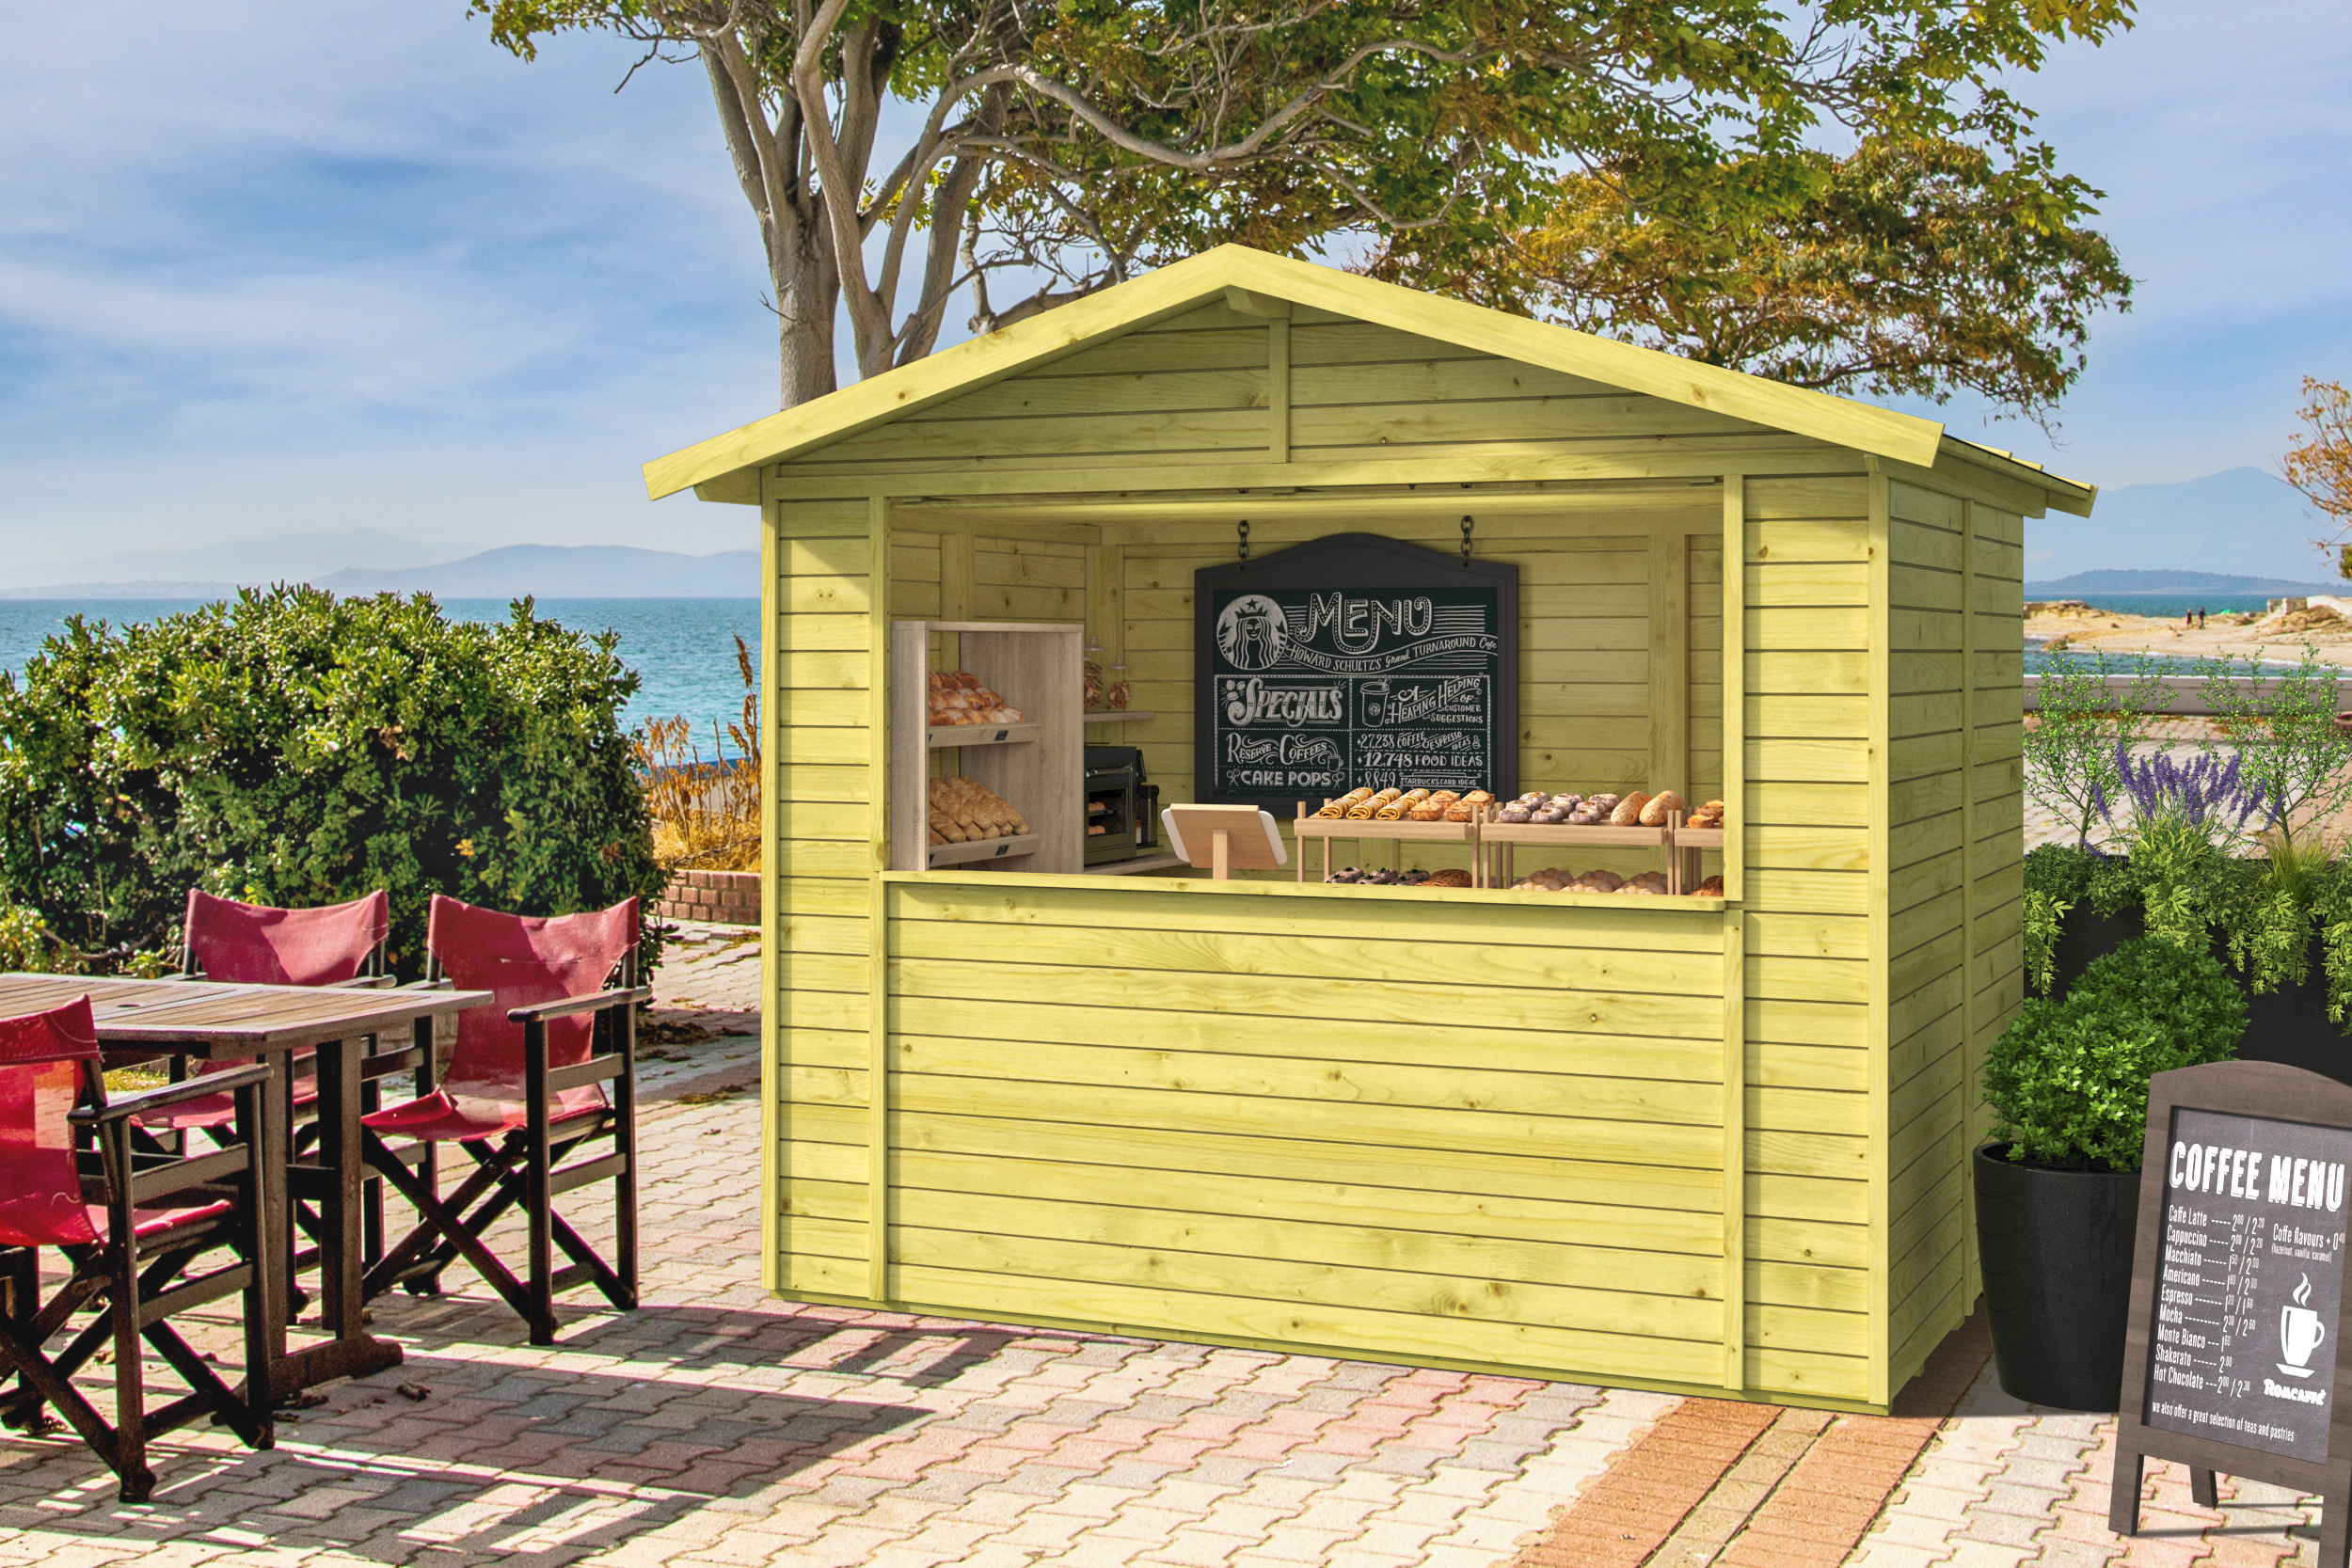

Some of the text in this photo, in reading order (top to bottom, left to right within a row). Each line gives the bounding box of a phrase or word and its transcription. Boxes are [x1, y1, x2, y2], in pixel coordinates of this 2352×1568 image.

[1295, 592, 1432, 655] MENU
[1286, 637, 1497, 672] HOWARD SCHULTZ'S Grand TURNAROUND Cafe
[1227, 677, 1343, 727] SPECIALS
[1385, 677, 1481, 723] HEAPING HELPING
[1397, 686, 1420, 702] A
[1459, 694, 1474, 704] OF
[1430, 712, 1484, 724] SUGGESTIONS
[1445, 705, 1482, 713] CUSTOMER
[1226, 732, 1327, 766] RESERVE COFFEES
[1360, 733, 1394, 749] 27,238
[1397, 731, 1425, 749] COFFEE
[1429, 731, 1463, 751] ESPRESSO
[1452, 736, 1471, 751] IDEAS
[1363, 752, 1483, 768] 12,748 FOOD IDEAS
[1240, 770, 1332, 787] CAKE POPS
[1364, 770, 1396, 790] 8849
[1400, 777, 1439, 785] STARBUCKS
[2169, 1141, 2345, 1212] COFFEE MENU
[2169, 1204, 2186, 1224] Caffe
[2188, 1207, 2207, 1227] Latte
[2167, 1224, 2207, 1247] Cappuccino
[2273, 1223, 2293, 1243] Coffe
[2294, 1227, 2324, 1248] flavours
[2165, 1243, 2201, 1267] Macchiato
[2163, 1264, 2201, 1287] Americano
[2161, 1283, 2193, 1307] Espresso
[2159, 1303, 2183, 1324] Mocha
[2157, 1323, 2180, 1344] Monte
[2182, 1328, 2206, 1349] Bianco
[2155, 1343, 2192, 1367] Shakerato
[2153, 1363, 2168, 1382] Hot
[2168, 1366, 2203, 1390] Chocolate
[2152, 1402, 2160, 1413] we
[2161, 1401, 2173, 1417] also
[2173, 1404, 2188, 1419] offer
[2192, 1409, 2208, 1424] great
[2209, 1413, 2235, 1429] selection
[2236, 1418, 2243, 1431] of
[2244, 1419, 2257, 1434] teas
[2258, 1423, 2269, 1437] and
[2269, 1425, 2295, 1443] pastries
